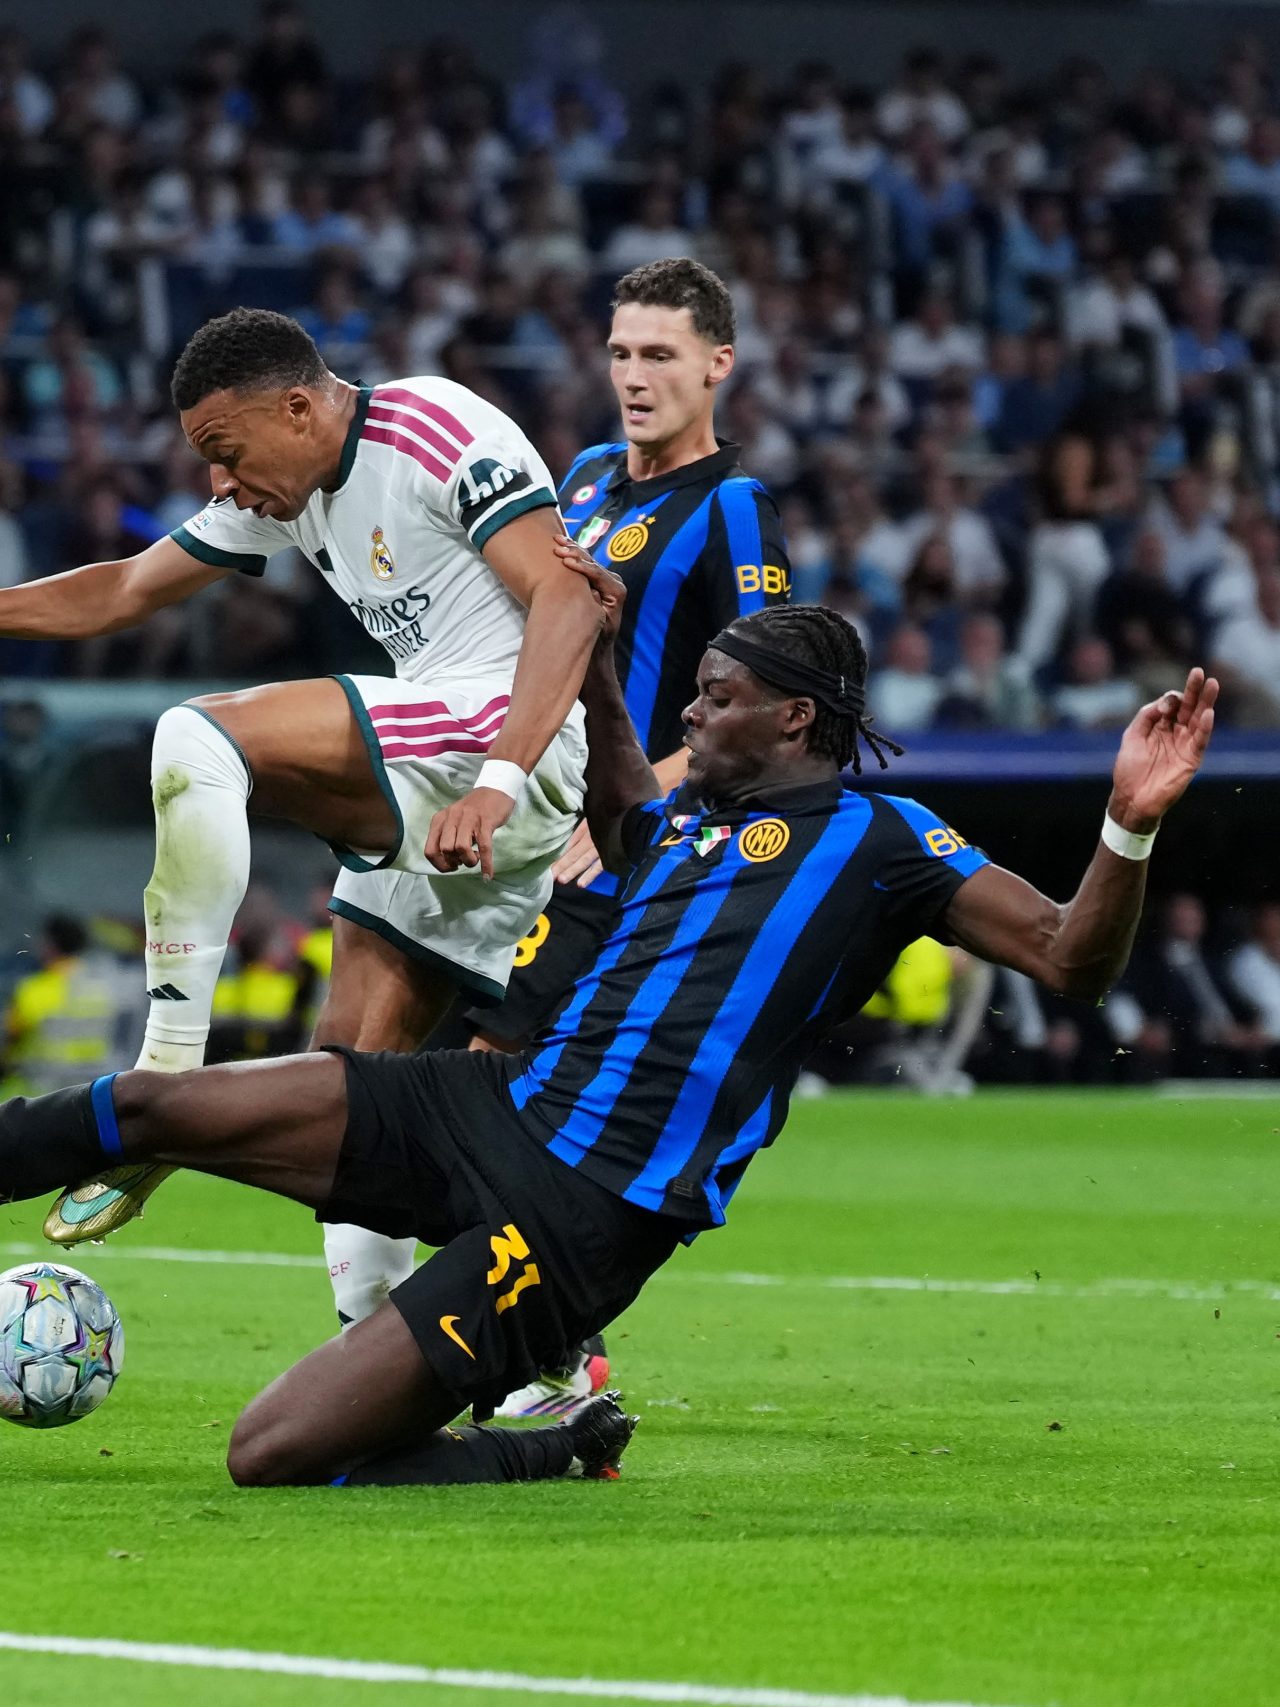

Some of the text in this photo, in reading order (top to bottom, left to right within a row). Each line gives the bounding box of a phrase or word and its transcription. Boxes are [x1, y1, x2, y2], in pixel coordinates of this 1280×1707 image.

[381, 620, 429, 659] ETTER
[146, 941, 196, 954] MCF
[487, 1224, 541, 1315] 31
